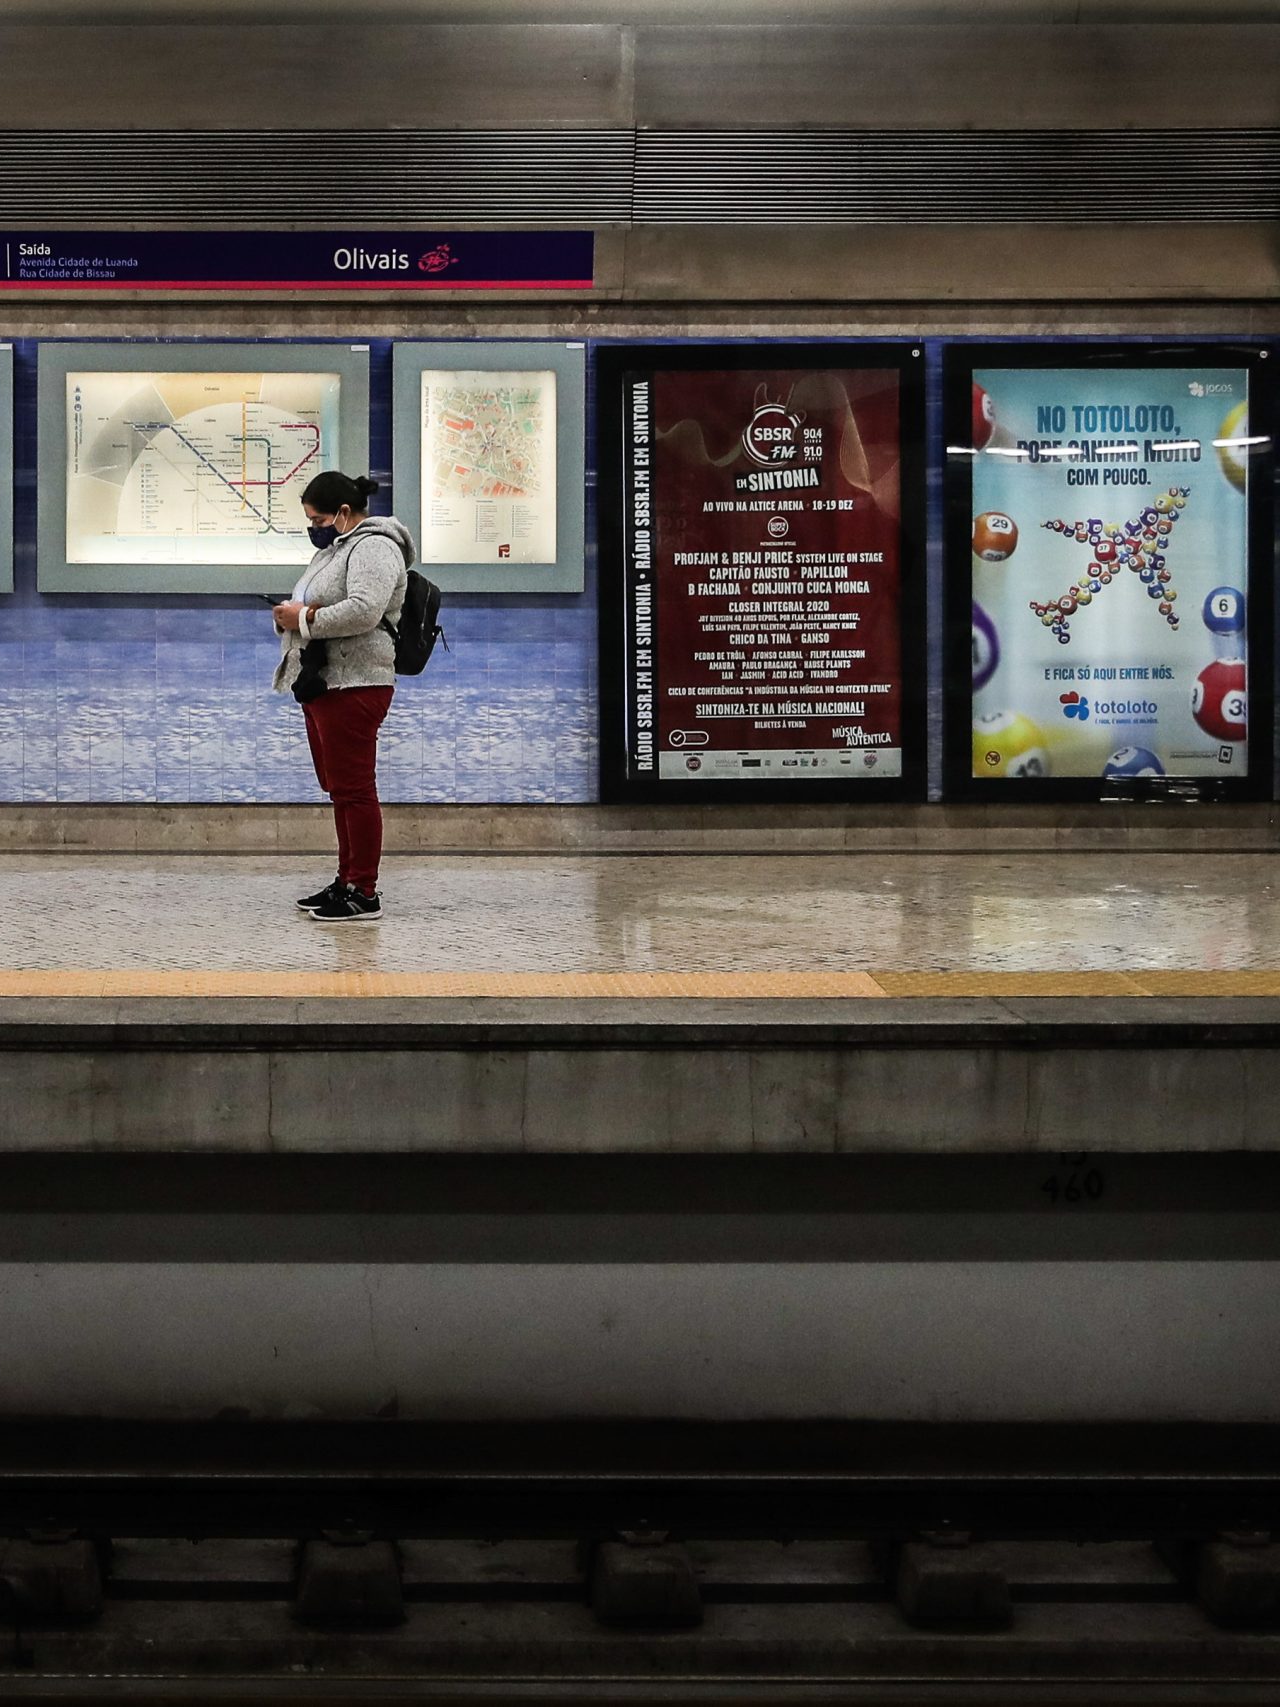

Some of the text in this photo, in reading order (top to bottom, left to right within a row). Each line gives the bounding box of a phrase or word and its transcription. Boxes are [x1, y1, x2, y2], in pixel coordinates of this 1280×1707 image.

[19, 243, 51, 255] Saída
[20, 258, 138, 267] Avenida Cidade de Luanda
[334, 248, 409, 270] Olivais
[20, 269, 116, 278] Rua Cidade de Bissau
[1037, 405, 1181, 435] NO TOTOLOTO,
[754, 427, 792, 441] SBSR
[803, 428, 822, 439] 90.4
[770, 446, 797, 459] FM
[803, 446, 822, 457] 91.0
[1017, 439, 1201, 463] PODE GANHAR MUITO
[632, 381, 651, 569] RÁDIO SBSR.FM EM SINTONIA
[736, 468, 819, 492] EM SINTONIA
[1067, 468, 1151, 485] COM POUCO.
[703, 500, 854, 512] AO VIVO NA ALTICE ARENA 18-19 DEZ
[992, 518, 1008, 529] 29
[674, 551, 883, 565] PROFJAM & BENJI PRICE SYSTEM LIVE ON STAGE
[709, 565, 848, 580] CAPITÃO FAUSTO PAPILLON
[688, 581, 870, 596] B FACHADA CONJUNTO CUCA MONGA
[728, 601, 830, 613] CLOSER INTEGRAL 2020
[1220, 599, 1228, 613] 6
[743, 614, 757, 622] ANOS
[808, 613, 838, 621] ALEXANDRE
[715, 624, 727, 632] SAN
[743, 623, 759, 631] FILIPE
[789, 622, 803, 630] JOÃO
[823, 622, 840, 630] NANCY
[729, 633, 830, 645] CHICO DA TINA GANSO
[694, 650, 866, 661] PEDRO DE TRÓIA AFONSO CABRAL FILIPE KARLSSON
[709, 660, 852, 670] AMAURA PAULO BRAGANÇA HAUSE PLANTS
[634, 583, 653, 771] RÁDIO SBSR.FM EM SINTONIA
[721, 670, 839, 680] IAN JASMIM ACID ACID IVANDRO
[1045, 664, 1175, 680] E FICA SÓ AQUI ENTRE NÓS.
[668, 687, 687, 696] CICLO
[687, 687, 696, 696] DE
[697, 685, 744, 695] CONFERÊNCIAS
[754, 685, 789, 695] INDÚSTRIA
[789, 686, 799, 694] DA
[800, 684, 824, 694] MÚSICA
[825, 685, 835, 694] NO
[835, 685, 869, 694] CONTEXTO
[696, 700, 865, 715] SINTONIZA-TE NA MÚSICA NACIONAL!
[1095, 700, 1158, 714] totoloto
[754, 721, 781, 729] BILHETES
[788, 720, 807, 728] VENDA
[832, 725, 863, 738] MÚSICA
[846, 732, 892, 746] AUTÊNTICA
[1040, 1168, 1104, 1203] 460
